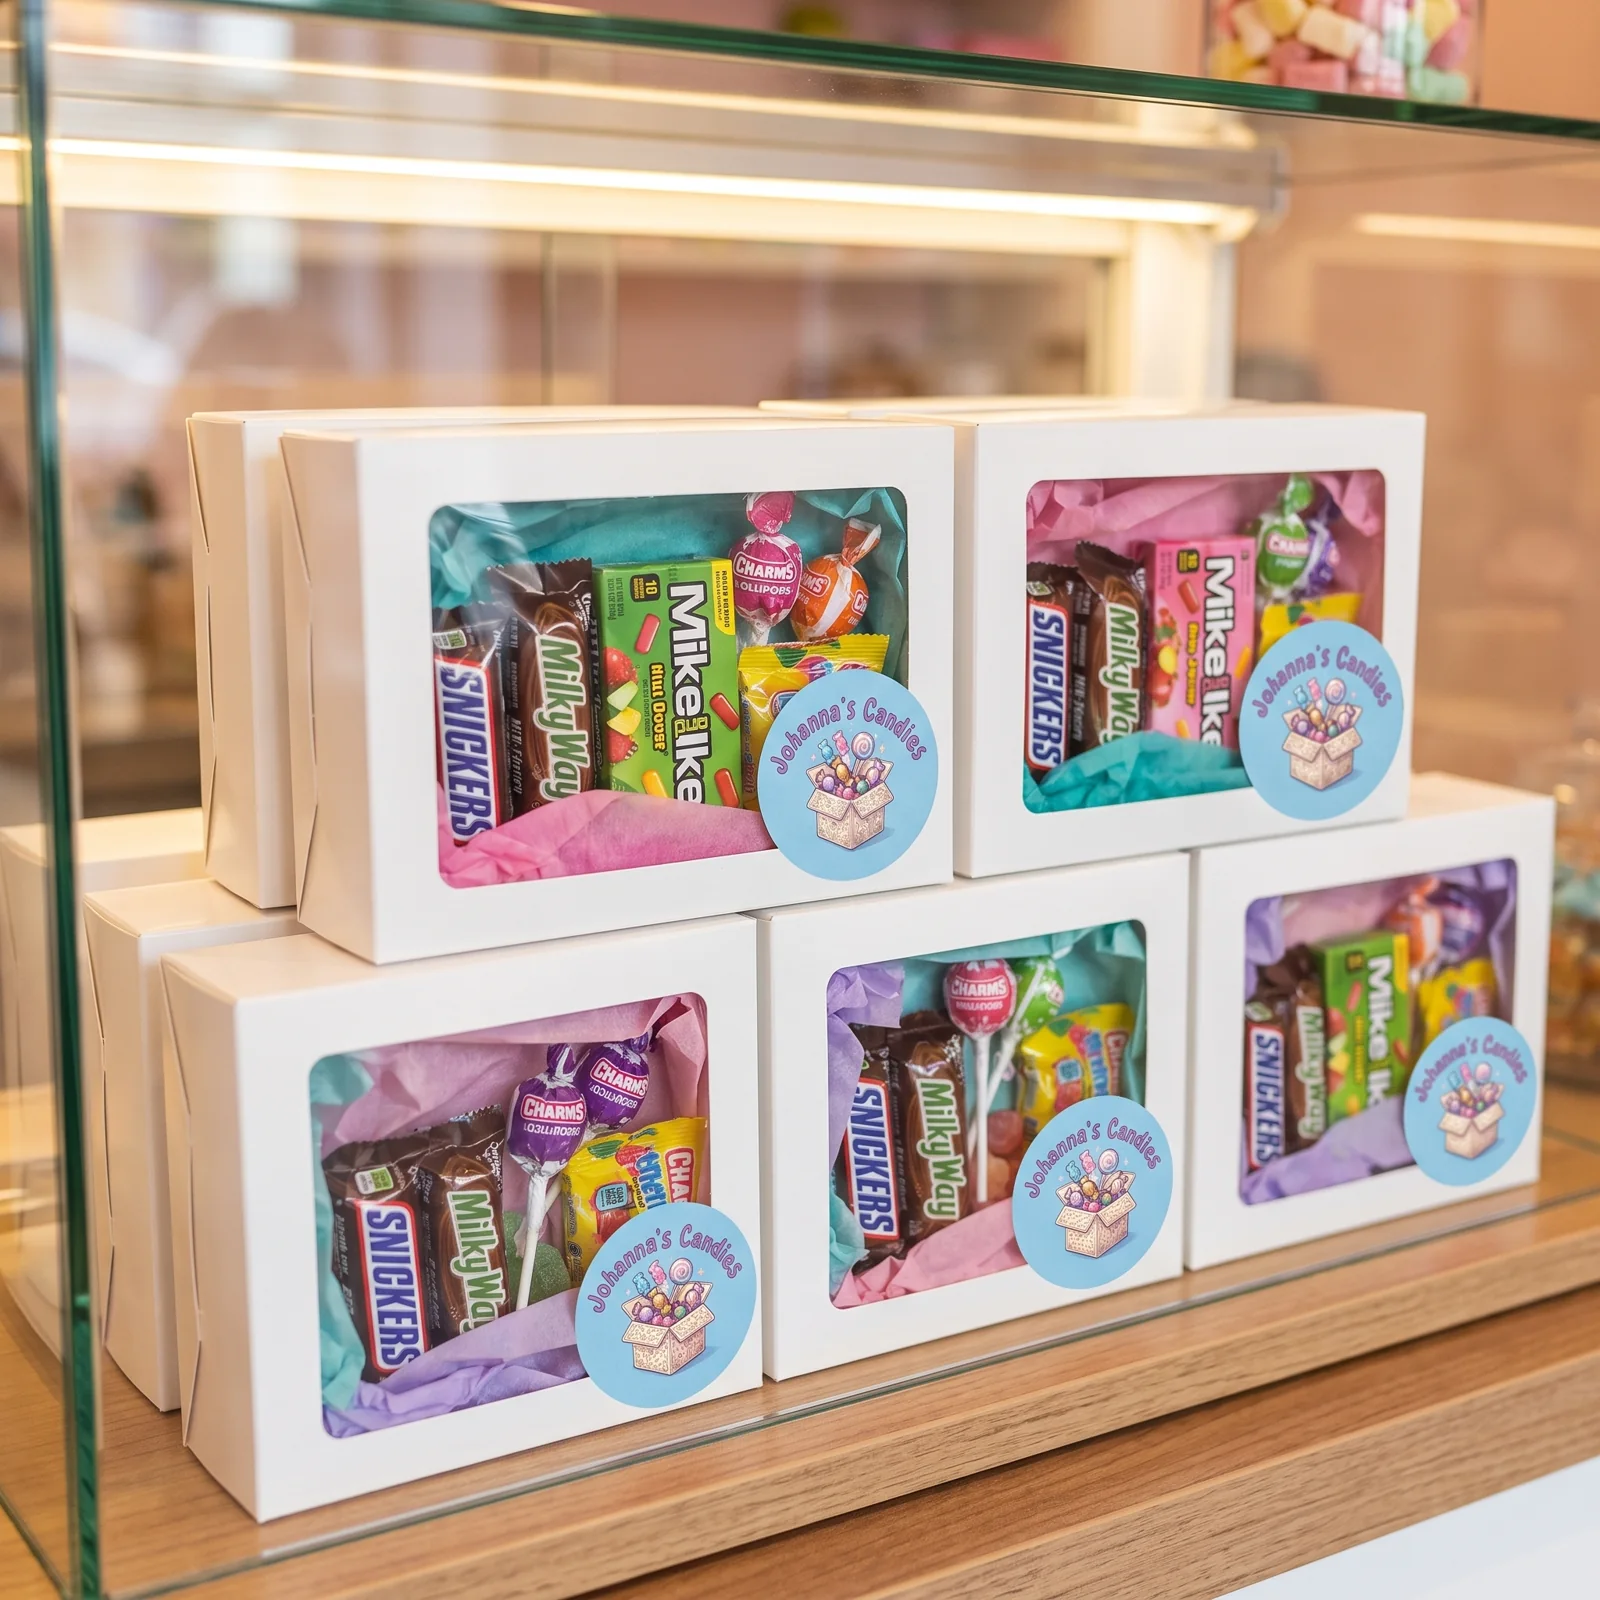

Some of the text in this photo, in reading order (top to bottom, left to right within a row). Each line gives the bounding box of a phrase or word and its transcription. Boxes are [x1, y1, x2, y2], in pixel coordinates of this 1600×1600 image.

[735, 556, 794, 581] CHARMS
[670, 584, 708, 716] Mike
[1102, 606, 1137, 688] Milky
[1204, 556, 1235, 671] Mike
[535, 634, 588, 799] Milky Way
[1032, 610, 1064, 764] SNICKERS
[1251, 644, 1331, 719] Johanna's
[1336, 645, 1393, 708] Candies
[439, 667, 493, 838] SNICKERS
[676, 732, 709, 804] Ike
[770, 696, 857, 776] Johanna's
[863, 696, 927, 761] Candies
[951, 978, 1007, 997] CHARMS
[1299, 1012, 1325, 1079] Milky
[1366, 955, 1394, 1106] Mike Ik
[1482, 1034, 1528, 1085] Candies
[523, 1097, 584, 1121] CHARMS
[593, 1060, 648, 1098] CHARMS
[1255, 1034, 1282, 1165] SNICKERS
[850, 1086, 895, 1233] SNICKERS
[919, 1081, 964, 1218] Milky Way
[1024, 1117, 1162, 1199] Johanna's Candies
[451, 1193, 496, 1273] Milky
[588, 1226, 672, 1314] Johanna's
[680, 1224, 742, 1280] Candies
[366, 1209, 421, 1367] SNICKERS
